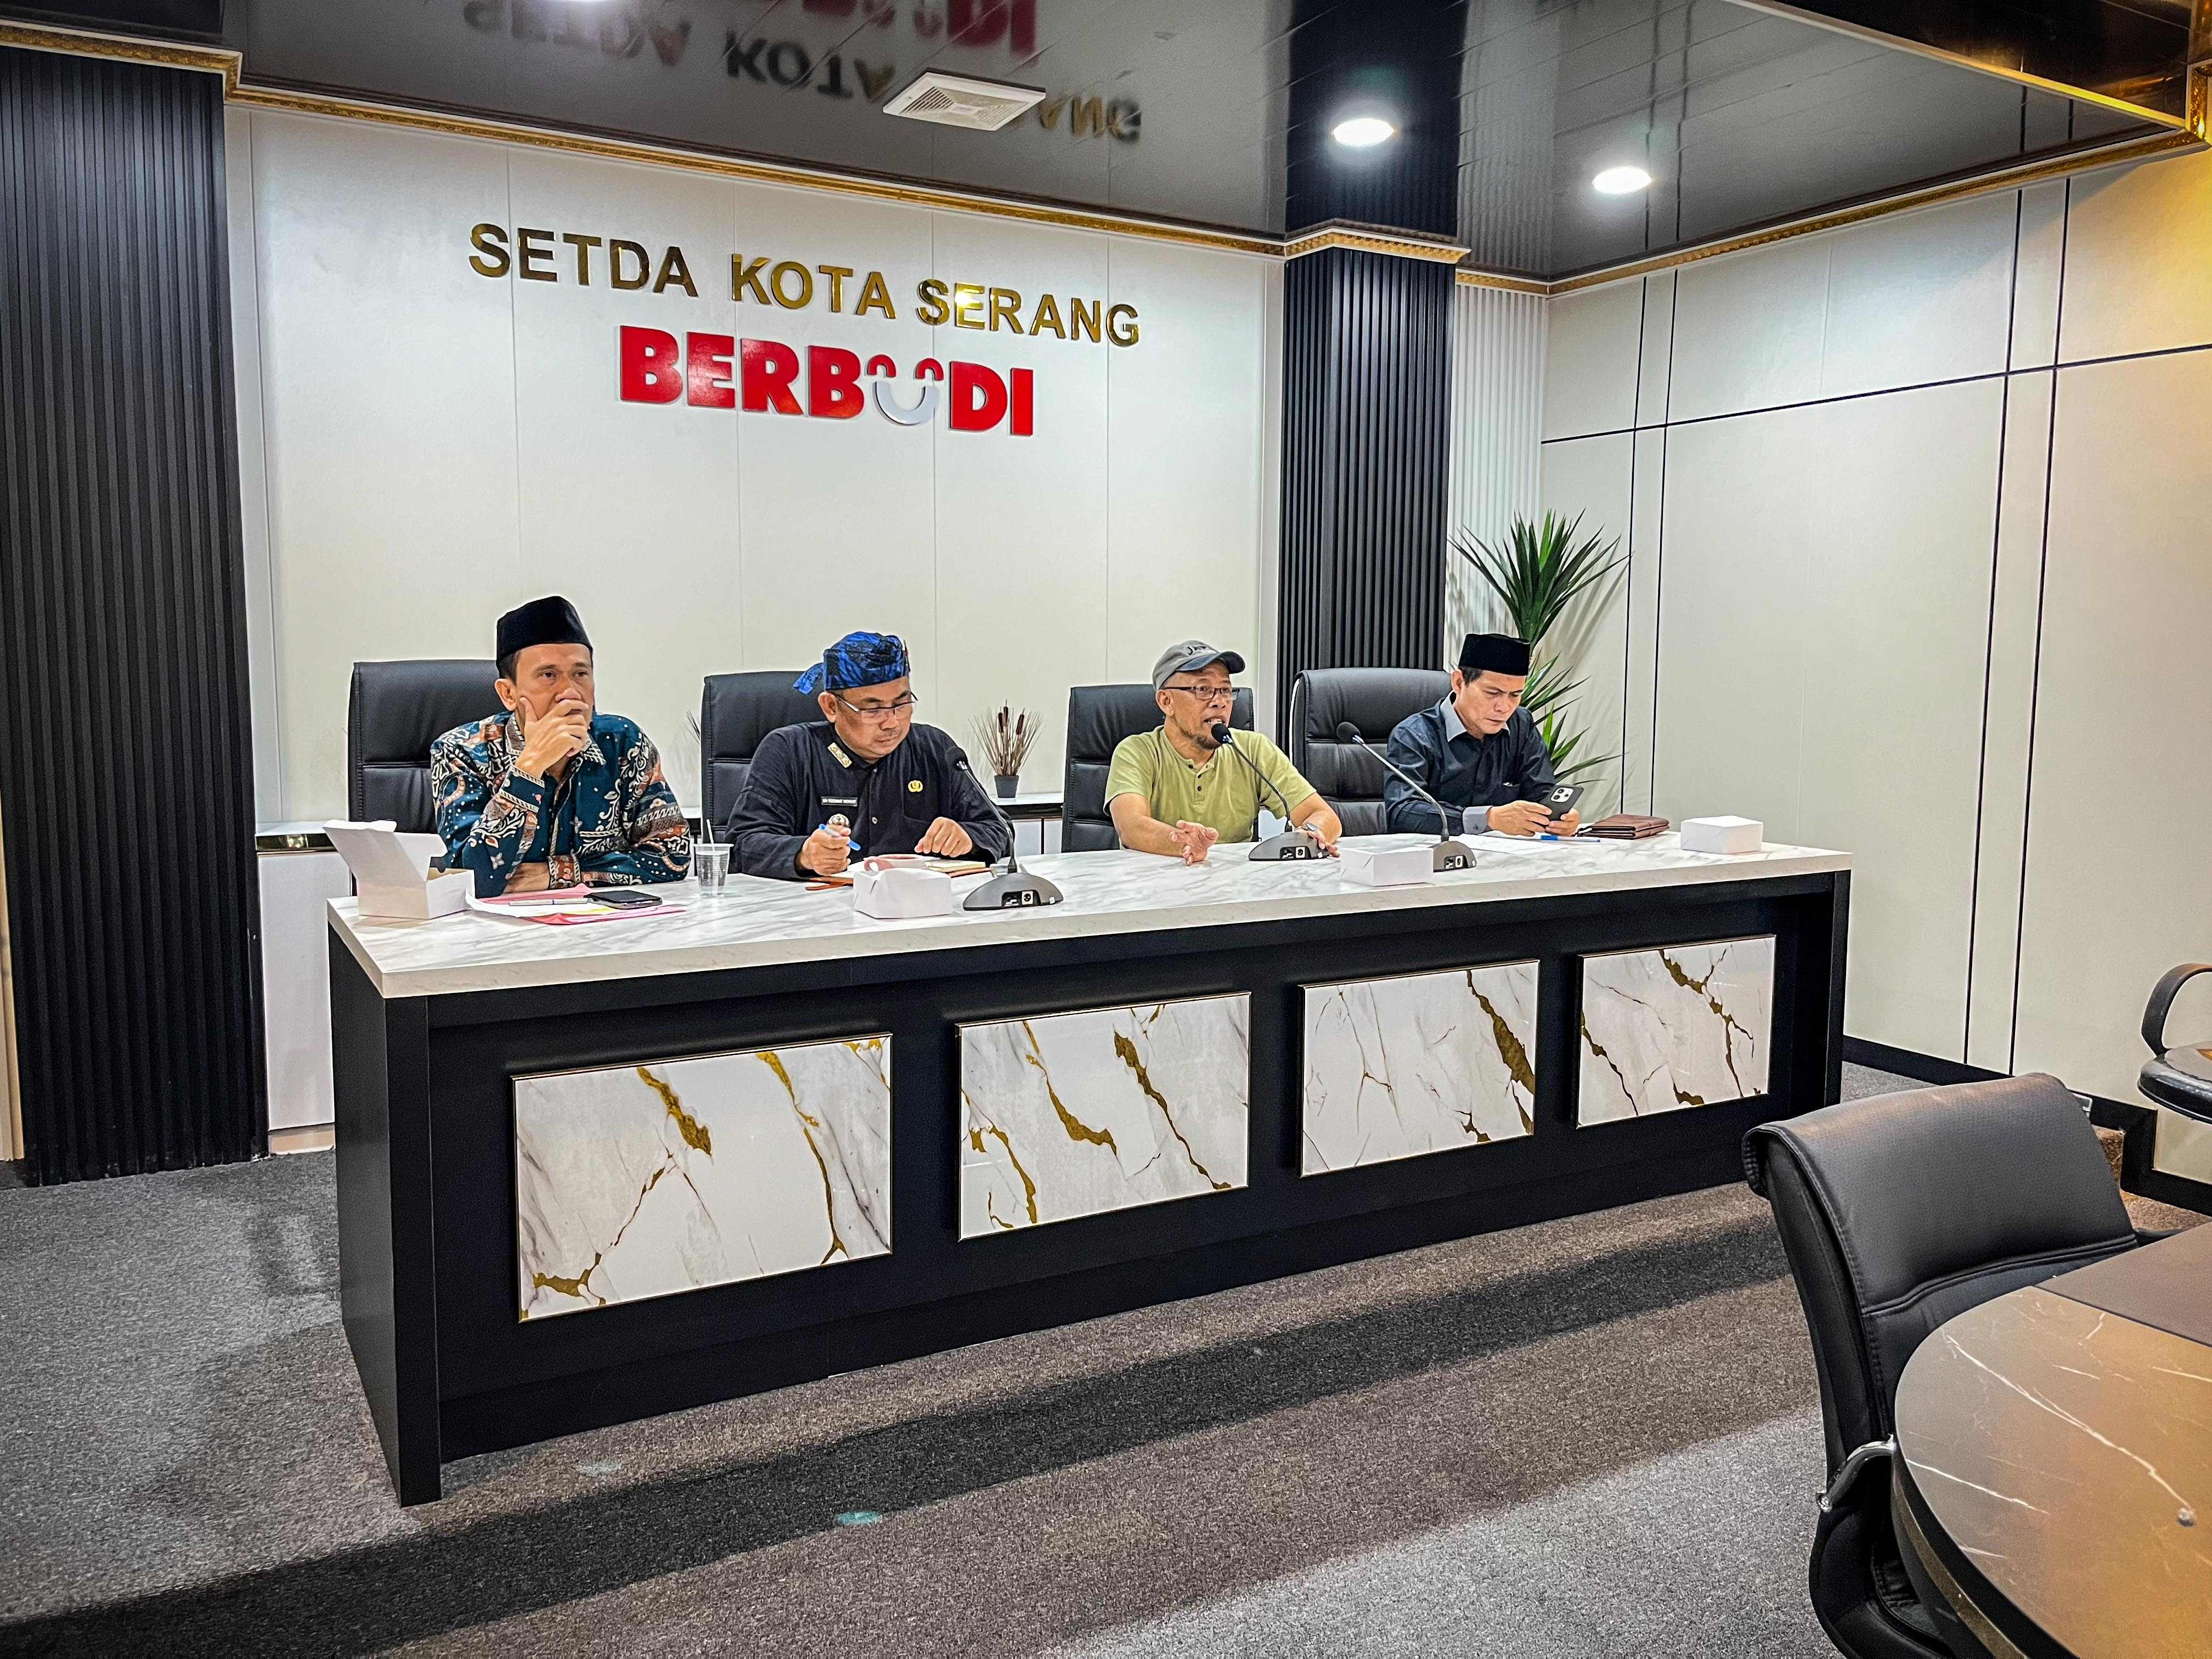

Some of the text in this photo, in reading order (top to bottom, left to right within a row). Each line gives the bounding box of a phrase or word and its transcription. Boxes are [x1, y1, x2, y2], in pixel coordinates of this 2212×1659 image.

[469, 223, 1141, 347] SETDA KOTA SERANG
[620, 325, 1034, 436] BERBUDI
